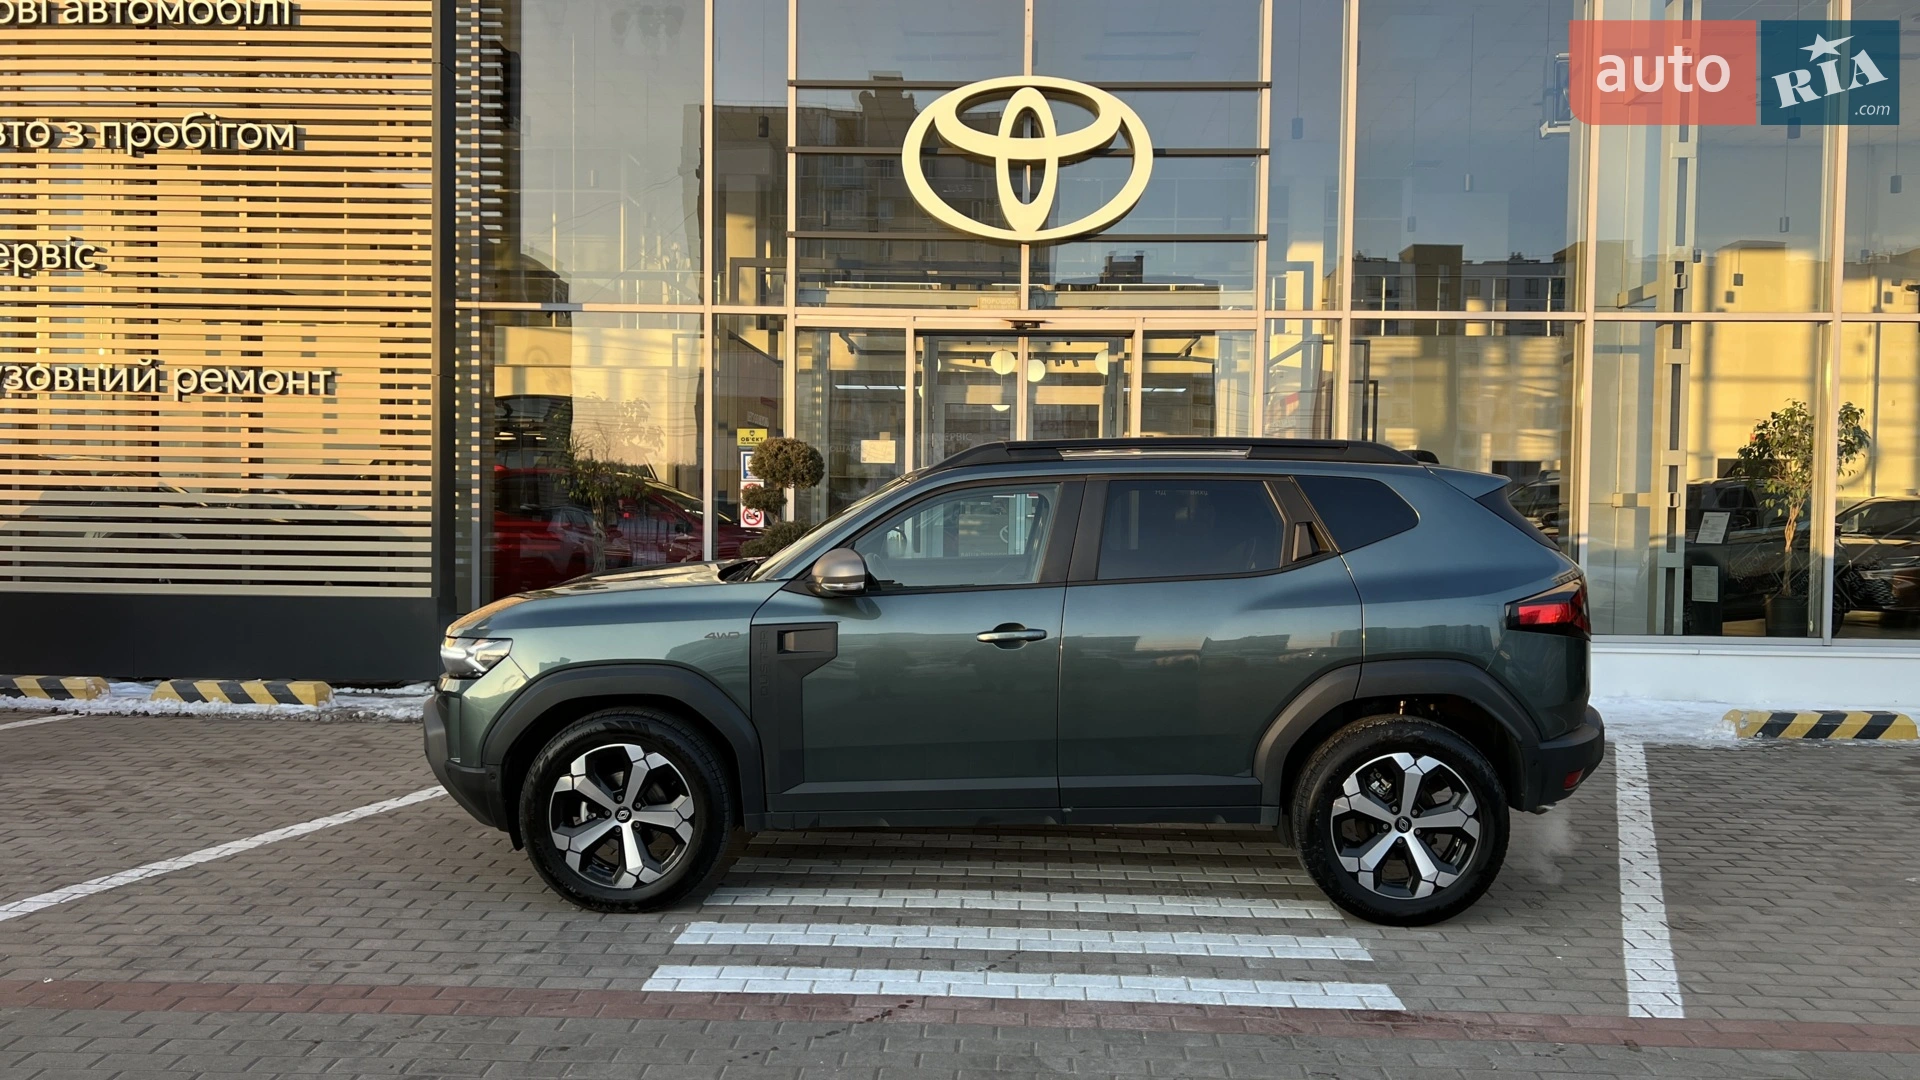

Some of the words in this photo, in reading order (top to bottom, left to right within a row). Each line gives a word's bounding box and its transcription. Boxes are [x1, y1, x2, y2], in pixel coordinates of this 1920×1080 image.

[62, 0, 290, 25] автомобілі
[64, 121, 85, 147] з
[100, 112, 295, 156] пробігом
[0, 358, 156, 392] зовний
[173, 367, 332, 401] ремонт
[704, 631, 740, 640] 4WD
[759, 630, 769, 697] DUSTER
